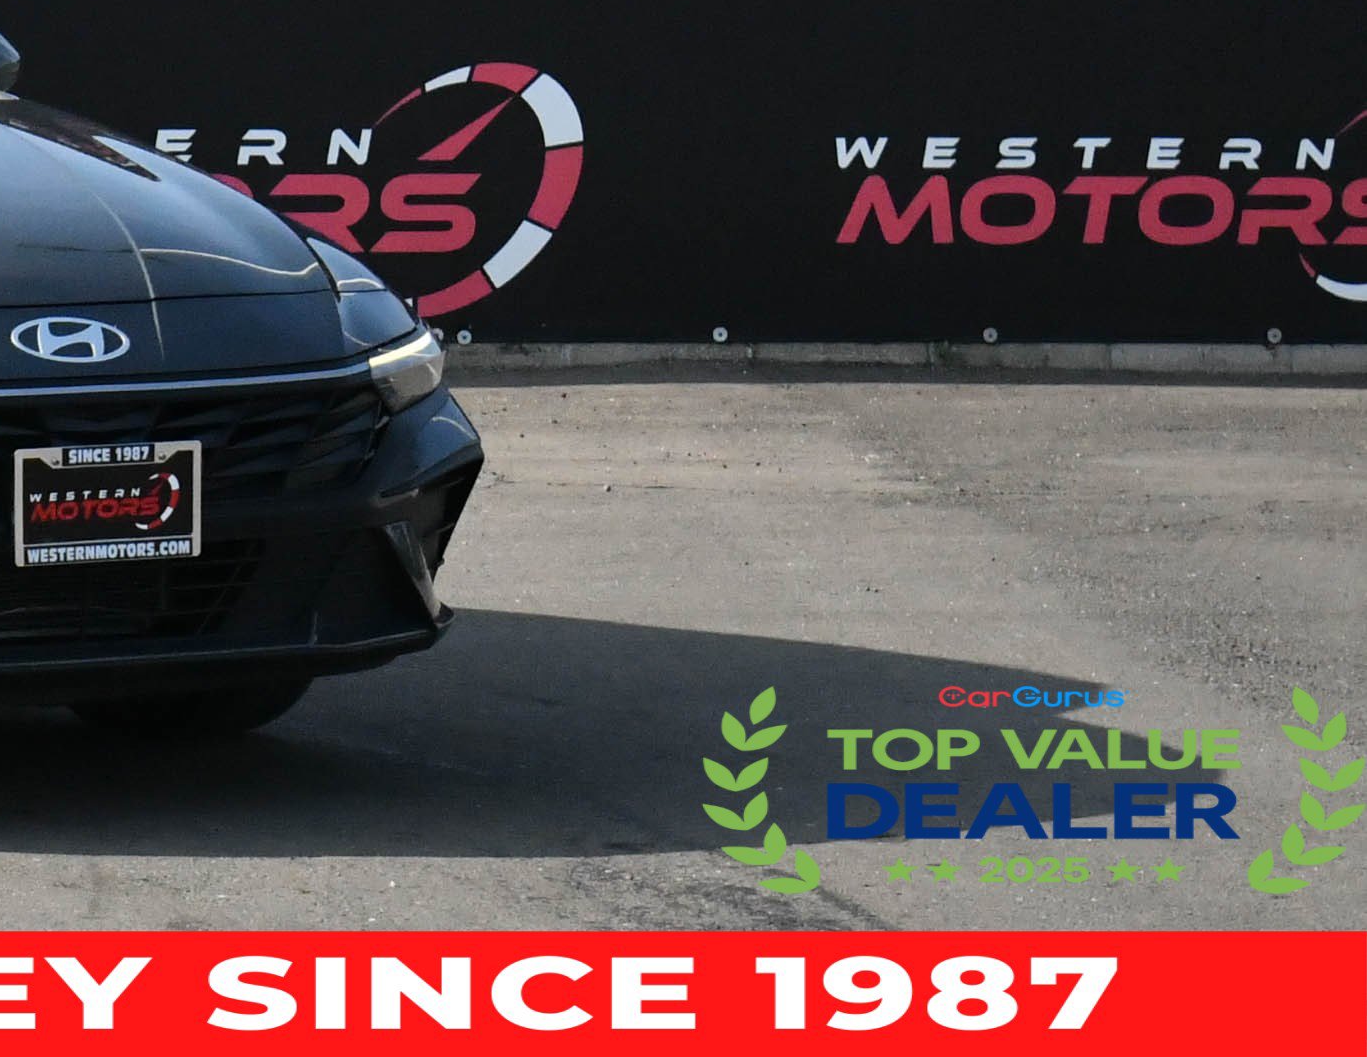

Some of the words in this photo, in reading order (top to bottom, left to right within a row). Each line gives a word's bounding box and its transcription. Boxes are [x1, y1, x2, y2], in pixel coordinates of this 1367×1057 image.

[835, 137, 1335, 170] WESTERN
[69, 448, 111, 464] SINCE
[115, 446, 150, 461] 1987
[29, 487, 141, 503] WESTERN
[30, 497, 160, 522] MOTORS
[27, 540, 191, 563] WESTERNMOTORS.COM
